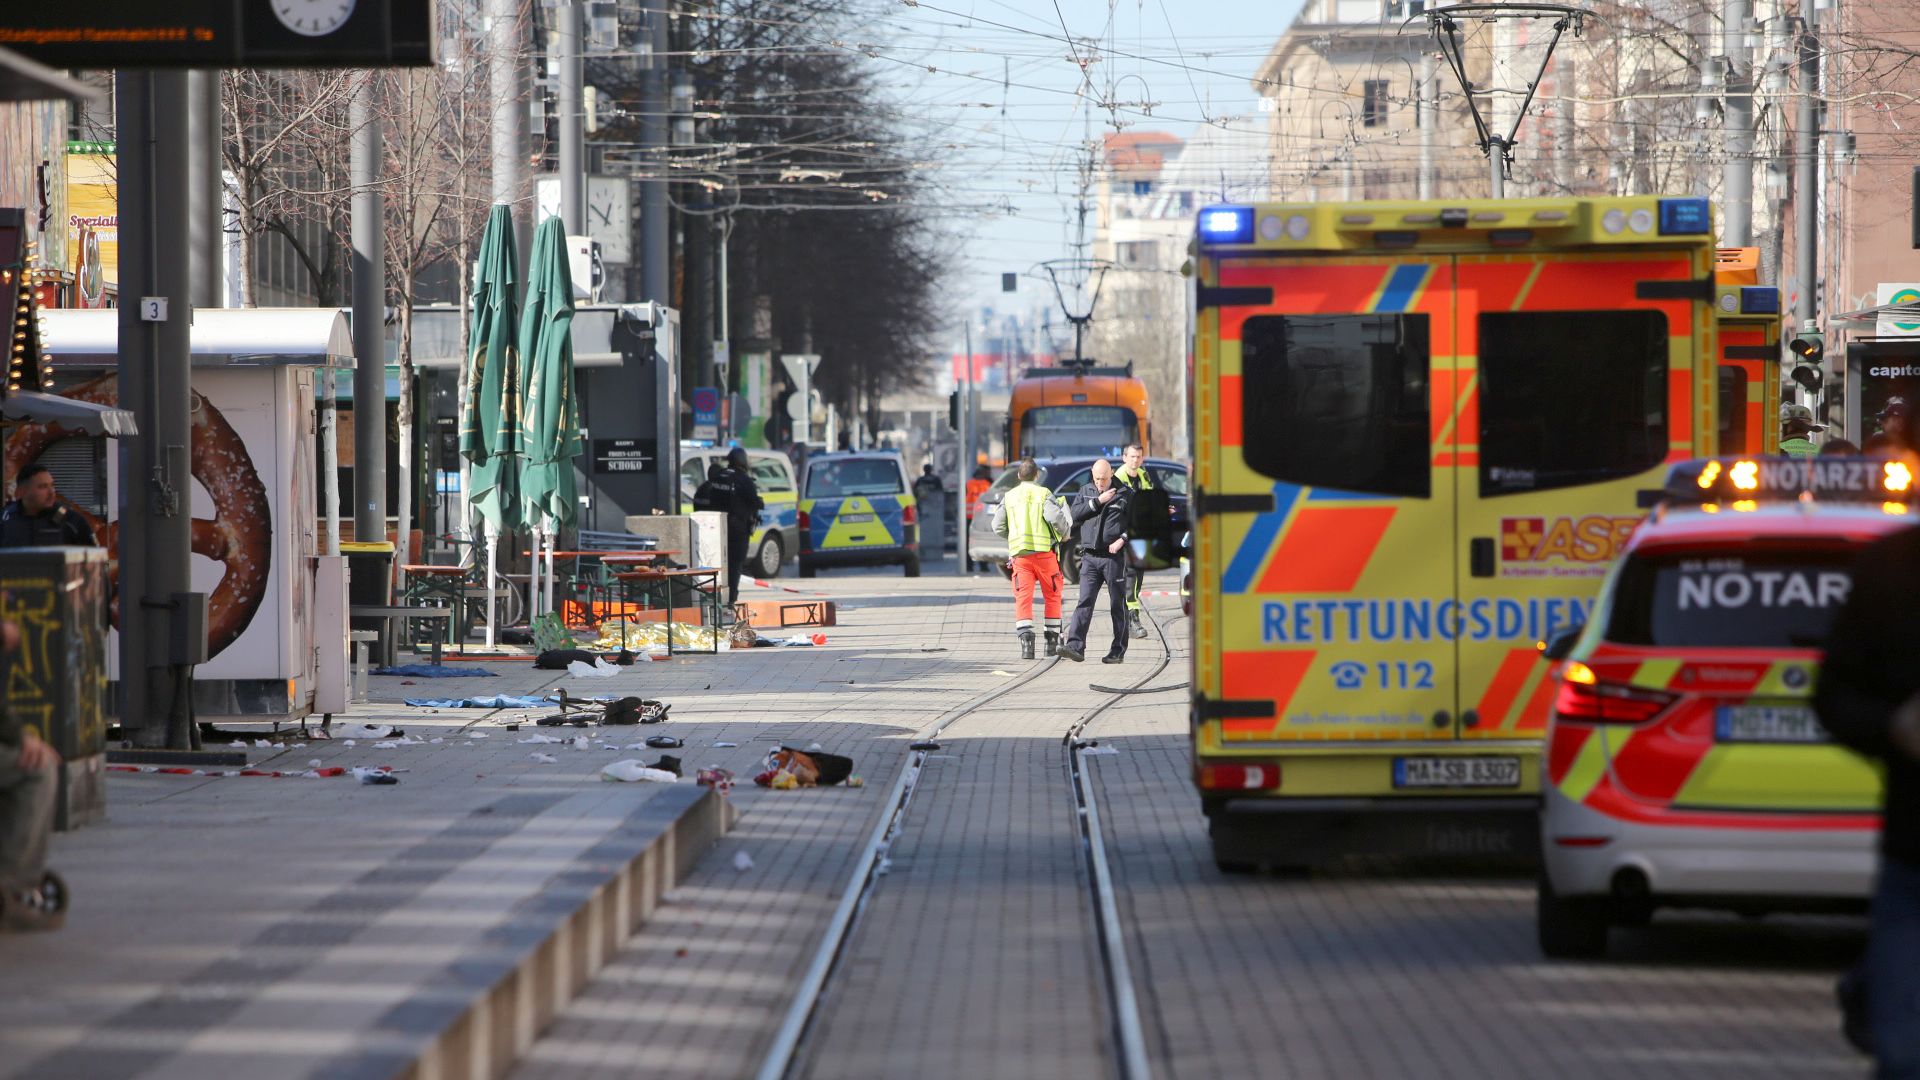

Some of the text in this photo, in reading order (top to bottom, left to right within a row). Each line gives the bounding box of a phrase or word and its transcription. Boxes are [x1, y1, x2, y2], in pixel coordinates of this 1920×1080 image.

[150, 302, 159, 319] 3
[608, 460, 643, 471] SCHOKO
[1760, 461, 1880, 491] NOTARZT
[1376, 661, 1435, 689] 112
